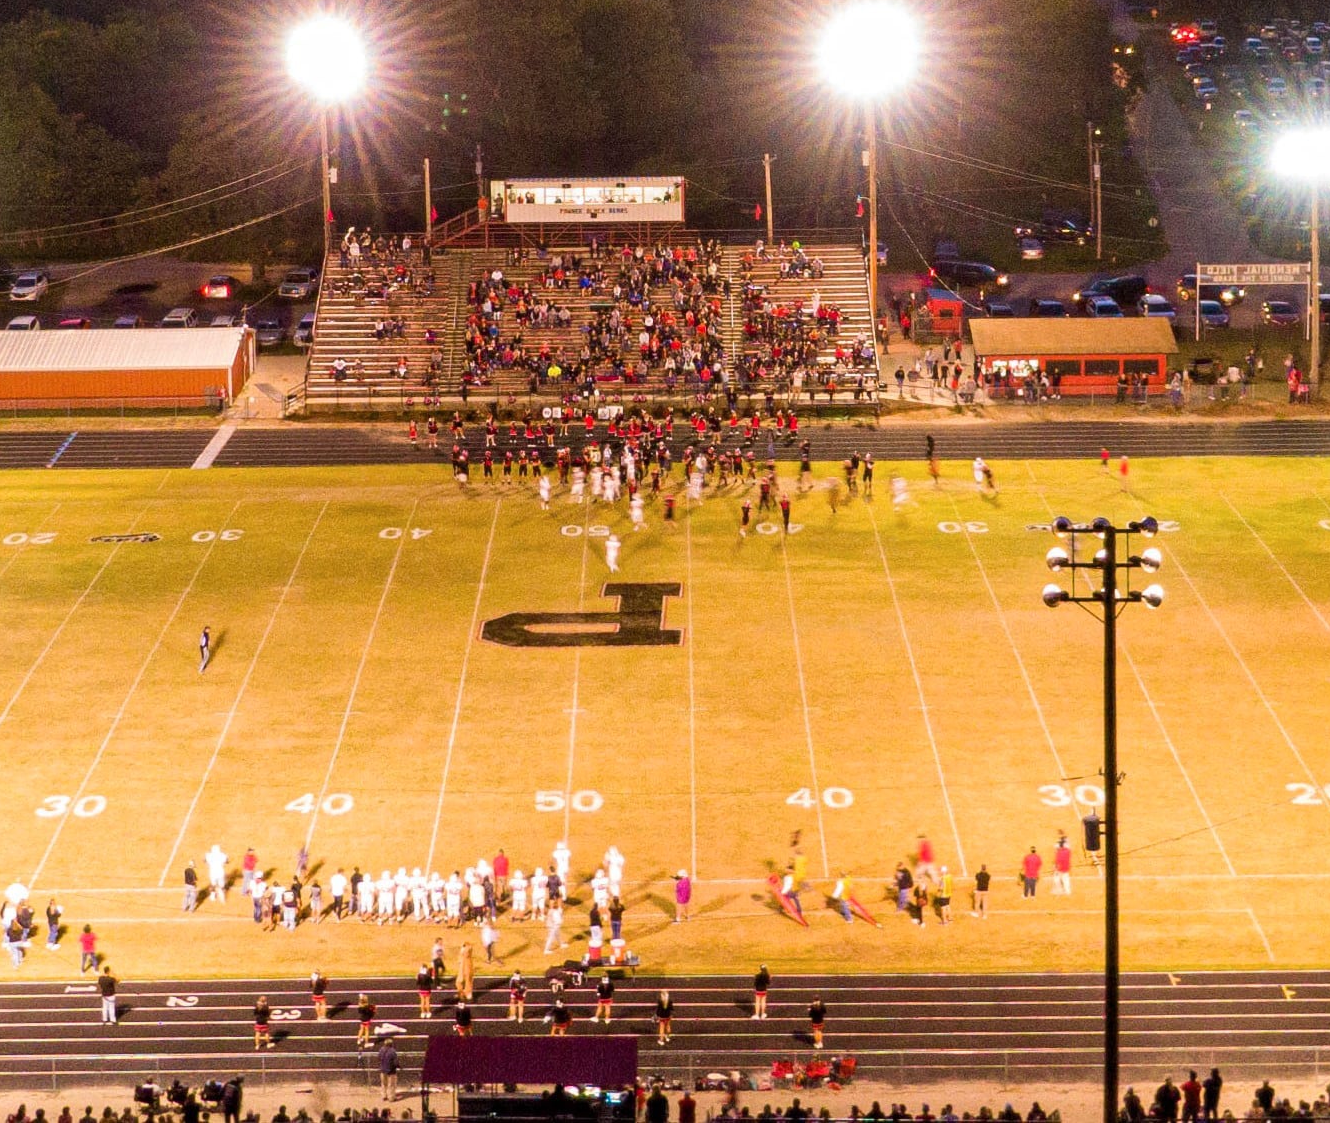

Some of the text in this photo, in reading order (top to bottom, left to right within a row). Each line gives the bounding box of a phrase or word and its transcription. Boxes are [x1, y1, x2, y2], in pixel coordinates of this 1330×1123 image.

[378, 527, 433, 539] 40
[560, 524, 610, 537] 50
[937, 521, 990, 534] 30
[2, 532, 58, 545] 20
[191, 529, 245, 542] 30
[534, 790, 604, 812] 50
[785, 787, 854, 808] 40
[1036, 784, 1106, 807] 30
[35, 795, 107, 817] 30
[284, 793, 354, 815] 40
[166, 996, 199, 1007] 2
[270, 1009, 302, 1020] 3
